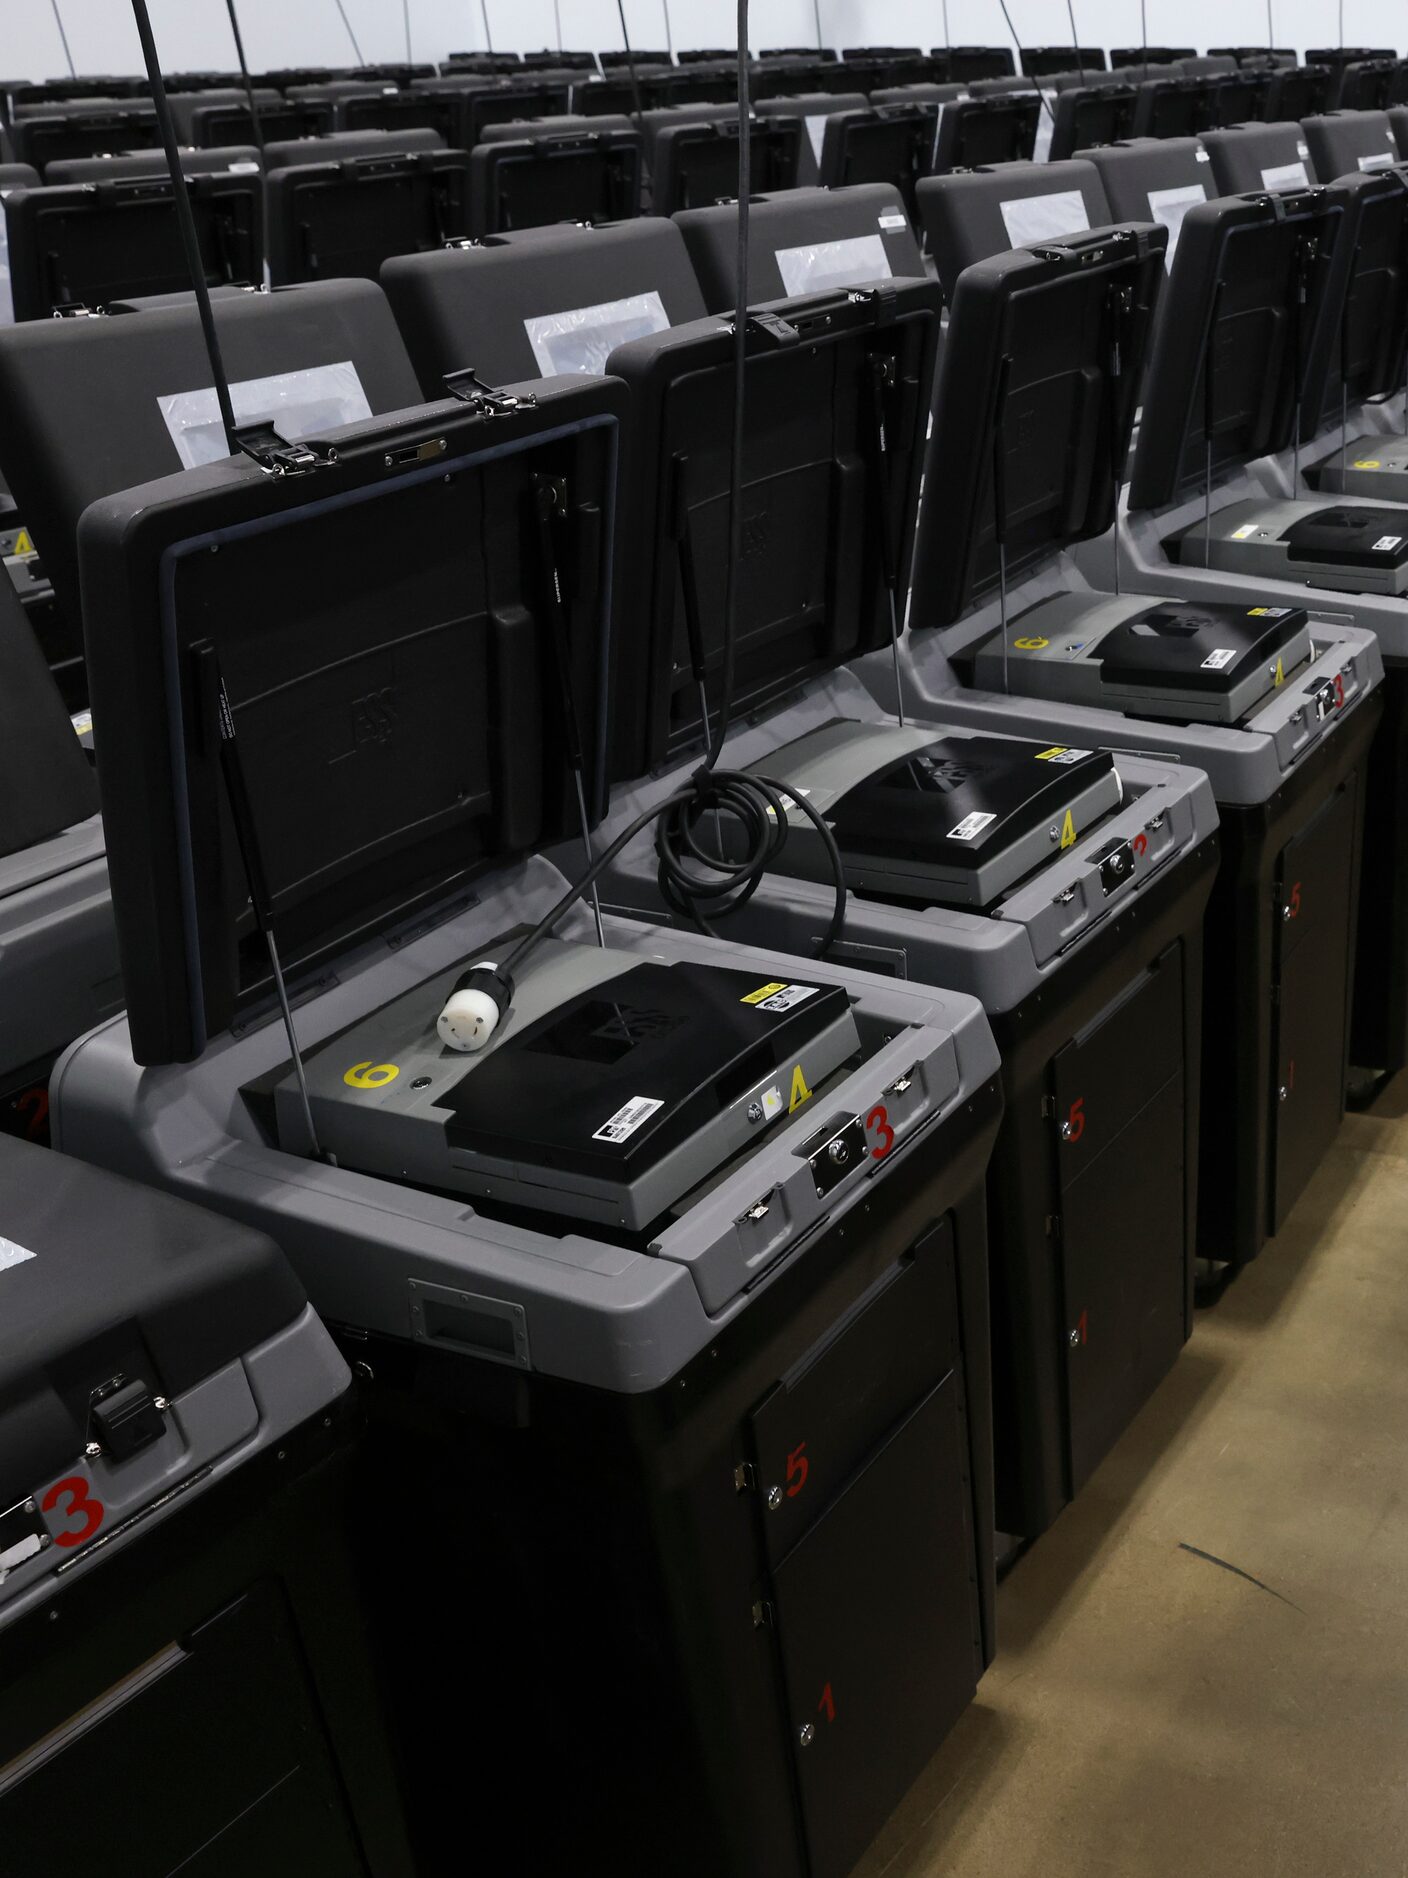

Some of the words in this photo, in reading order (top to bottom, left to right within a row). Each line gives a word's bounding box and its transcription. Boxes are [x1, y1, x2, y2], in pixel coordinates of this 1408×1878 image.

[1334, 675, 1344, 707] 3
[1060, 808, 1077, 851] 4
[1290, 882, 1301, 918] 5
[343, 1061, 401, 1089] 6
[788, 1065, 813, 1113] 4
[867, 1106, 895, 1160] 3
[1069, 1098, 1086, 1143] 5
[1078, 1308, 1088, 1346] 1
[786, 1441, 810, 1498] 5
[40, 1475, 105, 1548] 3
[818, 1683, 836, 1722] 1
